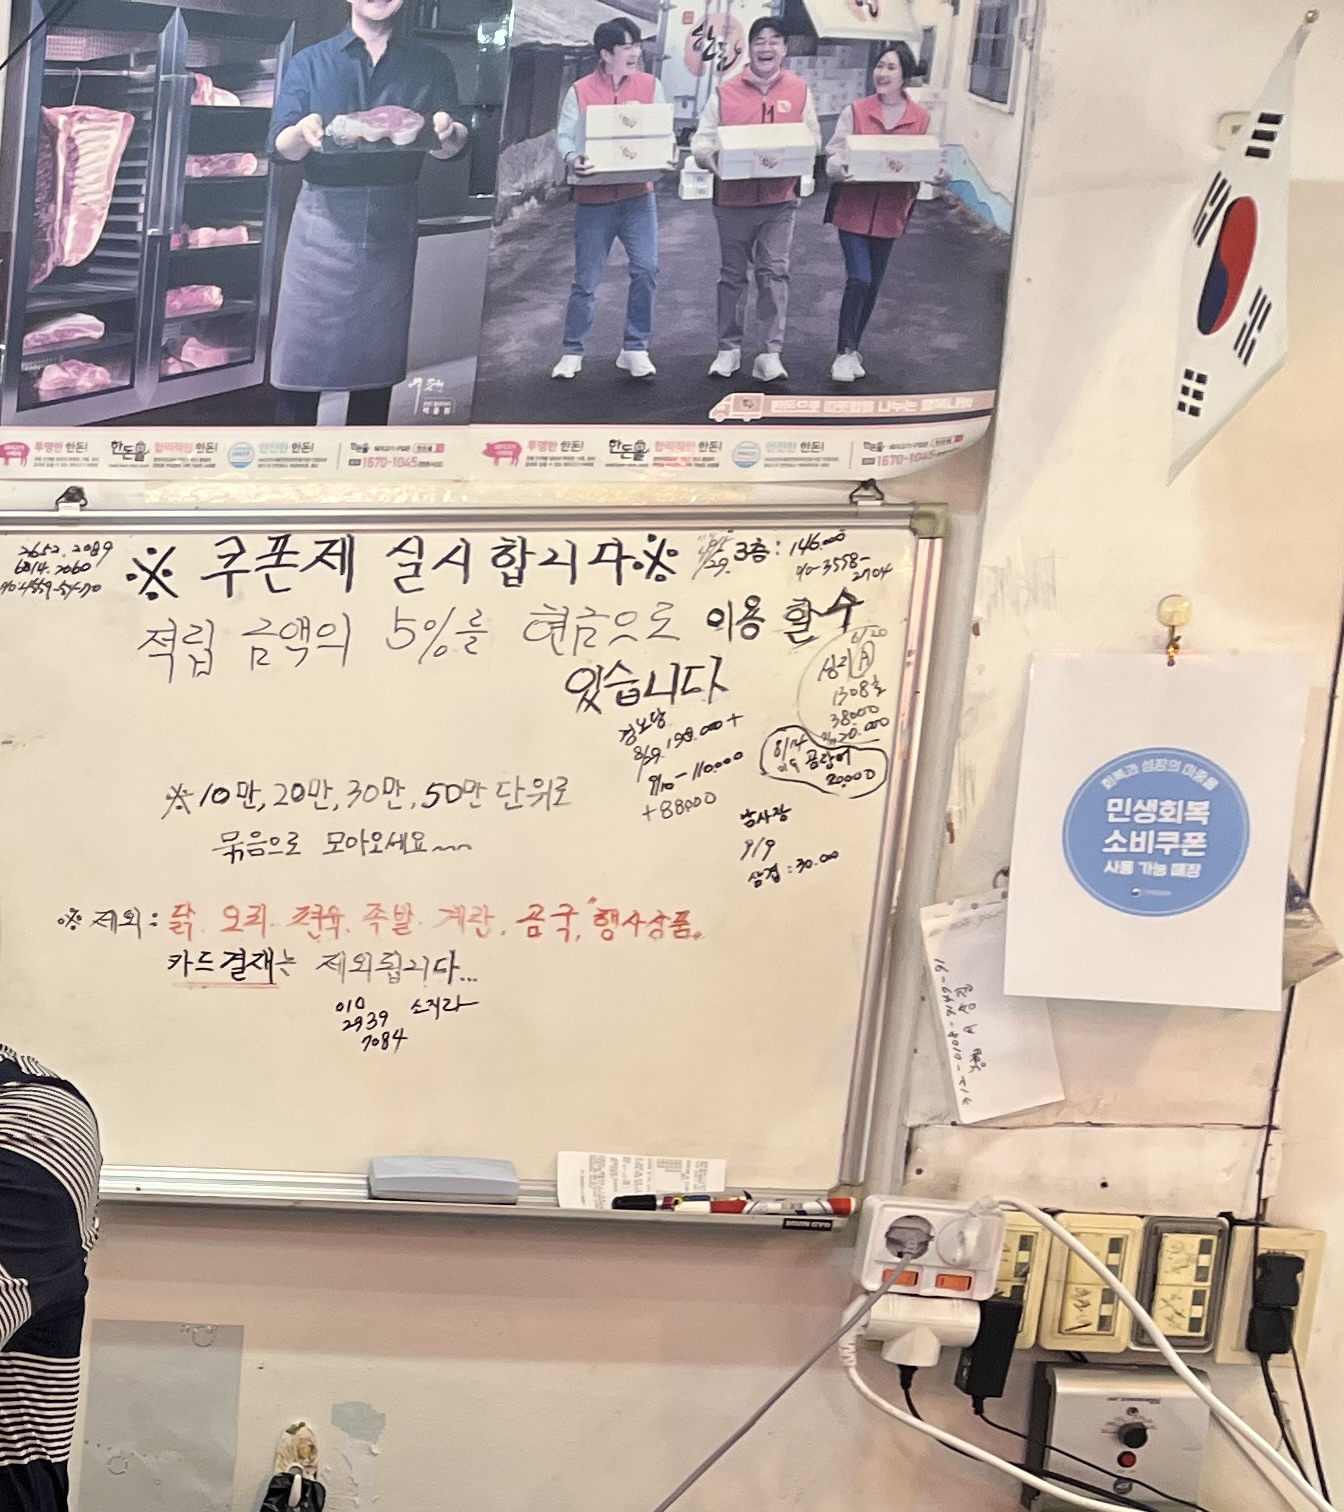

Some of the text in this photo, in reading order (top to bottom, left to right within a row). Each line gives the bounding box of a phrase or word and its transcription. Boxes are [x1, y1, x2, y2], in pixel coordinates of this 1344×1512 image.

[200, 533, 356, 600] 쿠폰제
[137, 616, 214, 684] 적립
[241, 613, 352, 670] 금액의
[385, 604, 490, 666] 5%를
[521, 601, 681, 656] 현금으로
[706, 594, 766, 643] 이용
[564, 655, 728, 714] 있습니다
[420, 775, 483, 810] 50만
[494, 775, 573, 810] 단위로
[1106, 797, 1211, 826] 민생회복
[212, 829, 302, 866] 묶음으로
[1101, 829, 1208, 857] 소비쿠폰
[1103, 859, 1134, 876] 사용
[1138, 860, 1168, 877] 가능
[334, 996, 366, 1014] 010
[341, 1009, 389, 1033] 2939
[360, 1027, 409, 1055] 7084
